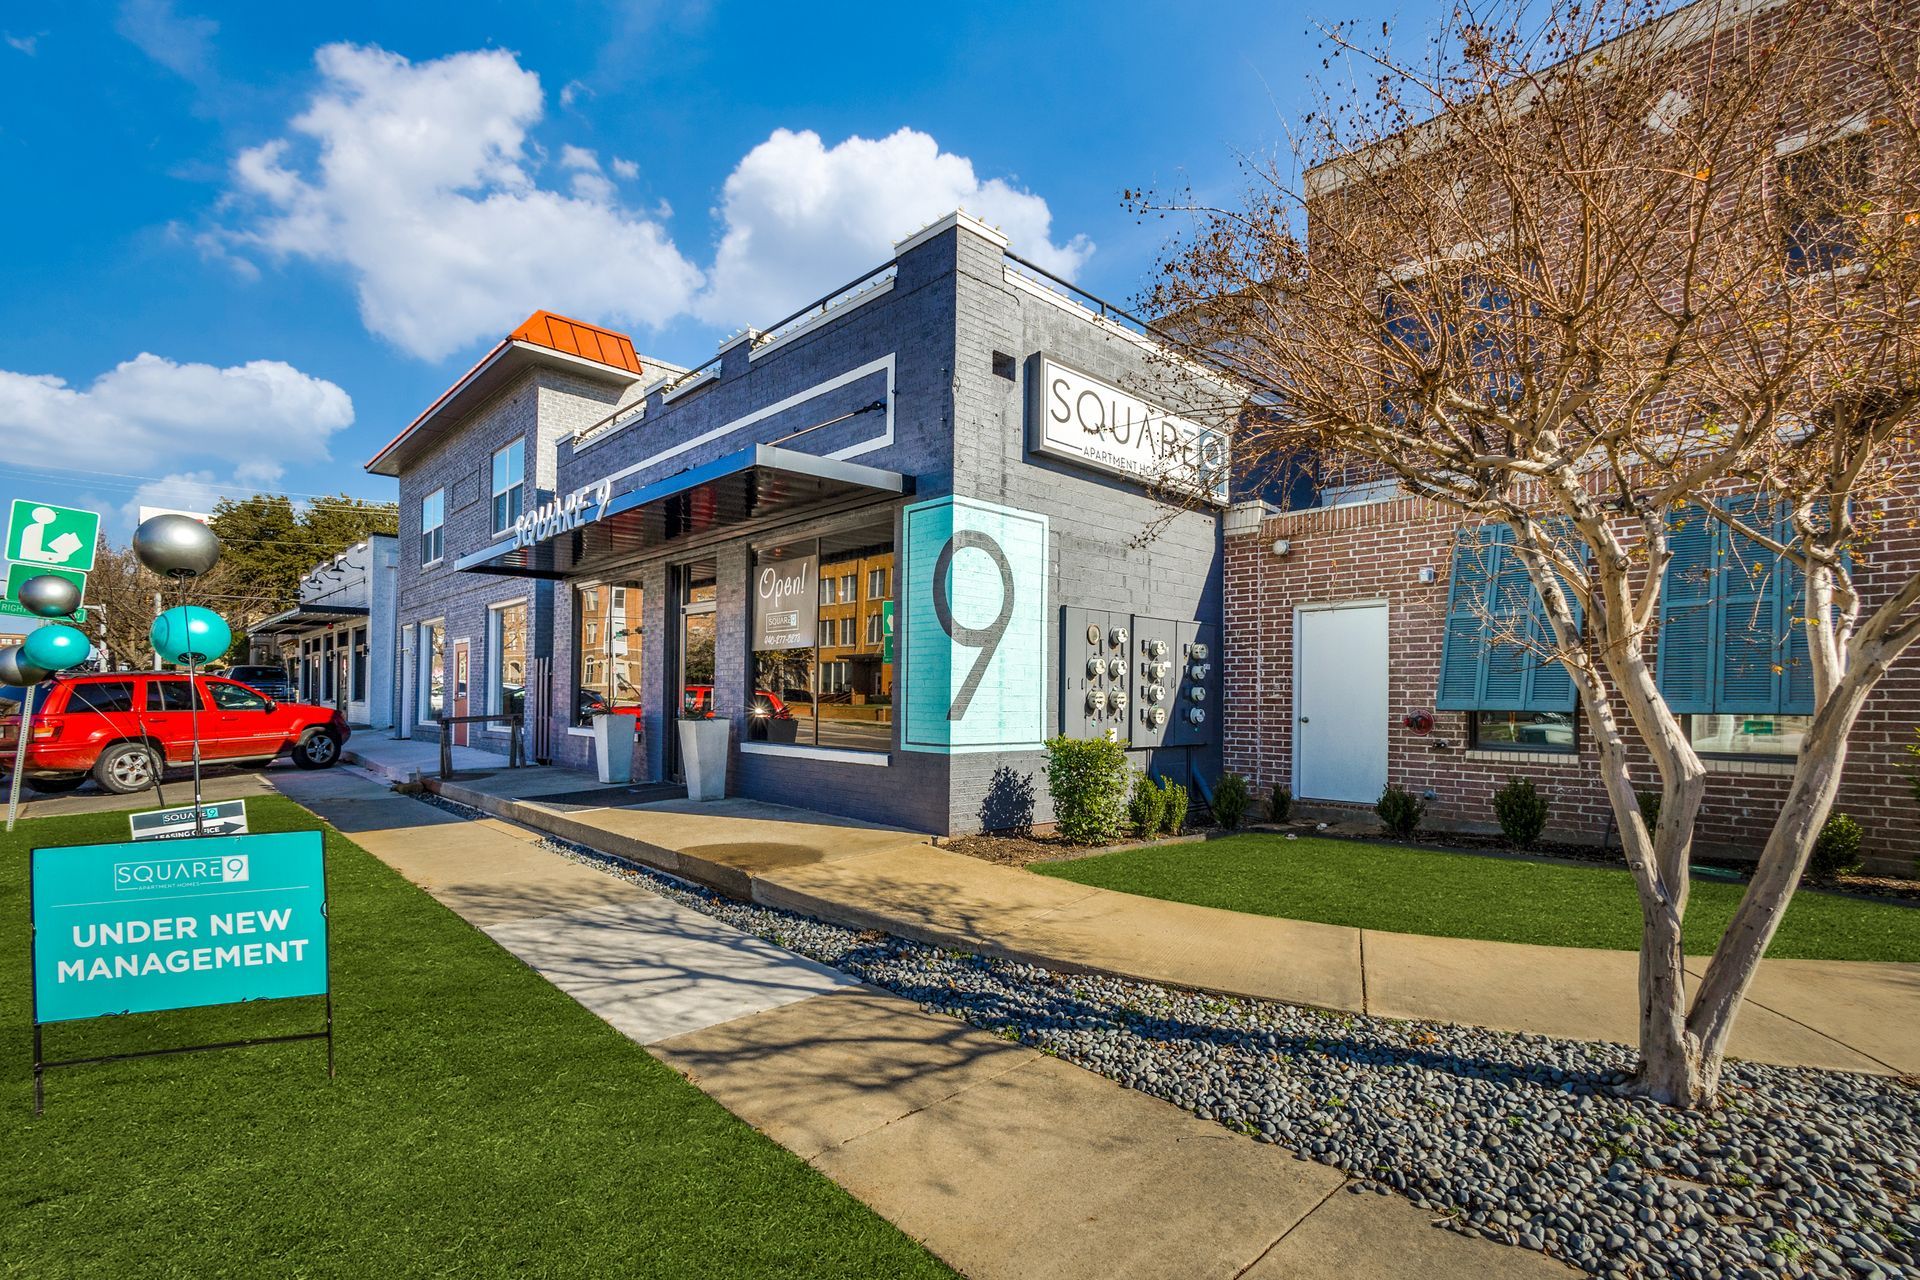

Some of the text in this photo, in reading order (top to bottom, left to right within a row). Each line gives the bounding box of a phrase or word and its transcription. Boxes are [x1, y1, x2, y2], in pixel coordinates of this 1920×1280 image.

[1050, 378, 1196, 469] SQUARE
[1083, 446, 1138, 471] APARTMENT
[512, 478, 611, 550] SQUARE 9
[760, 562, 807, 607] Open!
[932, 529, 1015, 721] 9
[155, 831, 190, 840] EASING
[163, 811, 207, 822] SQUAE
[118, 858, 244, 883] SQUARE 9
[138, 883, 176, 891] APARTMENT
[73, 908, 292, 948] UNDER NEW
[57, 939, 309, 984] MANAGEMENT
